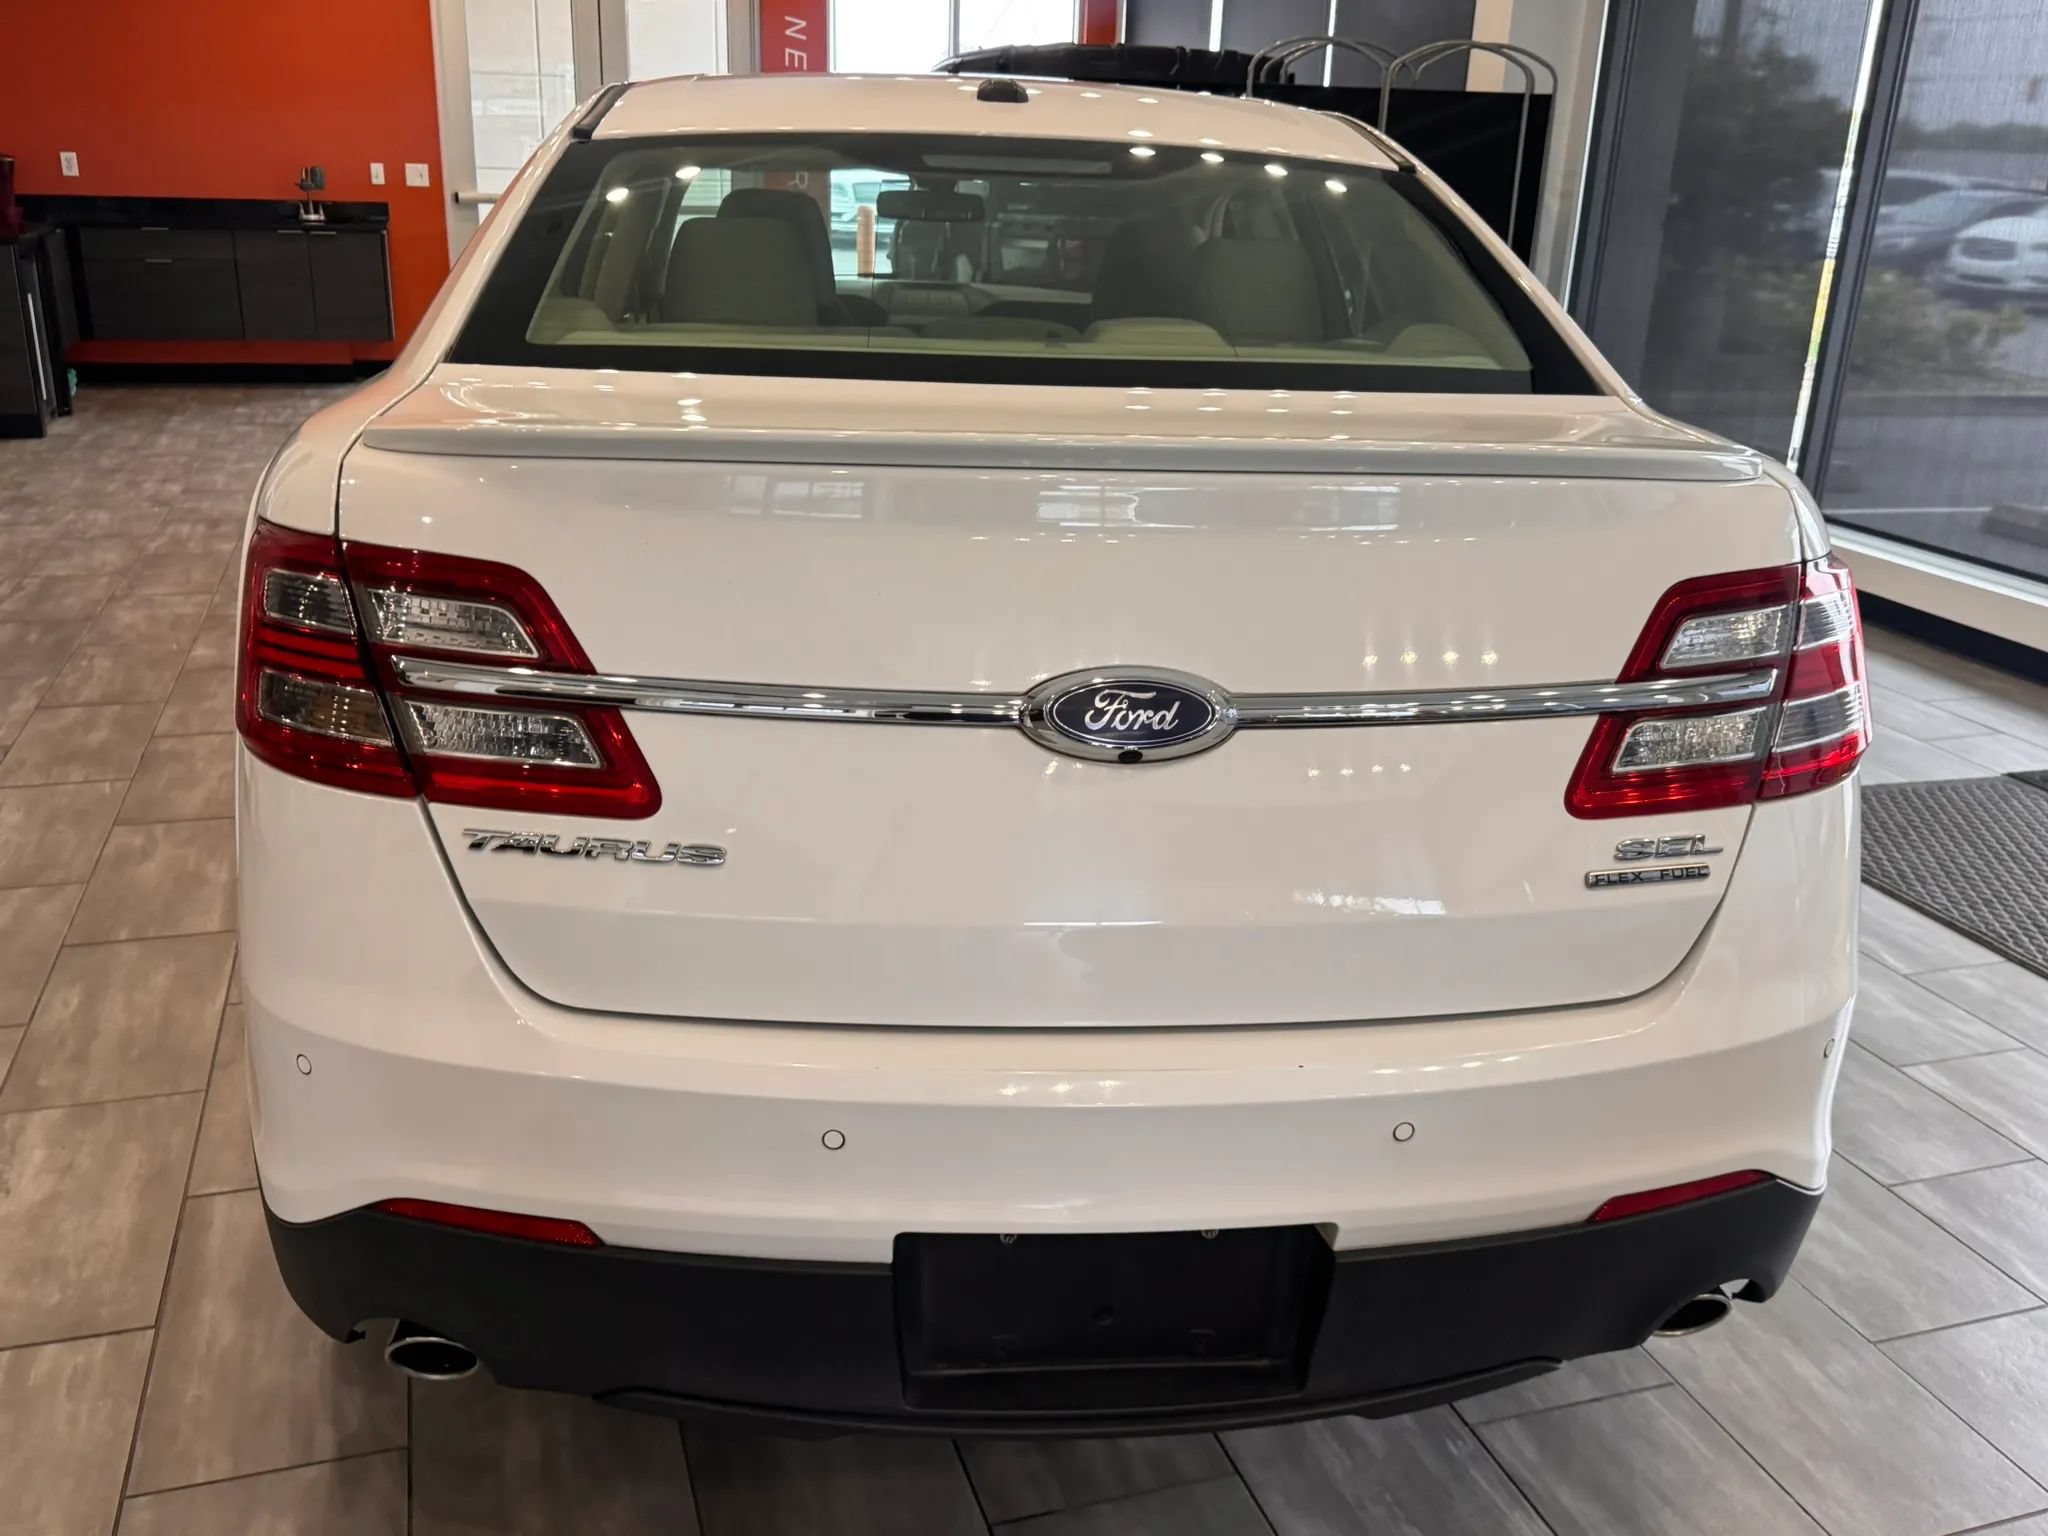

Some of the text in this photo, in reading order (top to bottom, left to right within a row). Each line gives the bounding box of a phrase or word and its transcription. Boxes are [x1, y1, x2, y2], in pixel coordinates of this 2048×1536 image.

[1084, 689, 1181, 731] Ford
[462, 828, 728, 866] TAURUS
[1613, 834, 1724, 861] SEL
[1594, 865, 1709, 886] FLEX FUEL
